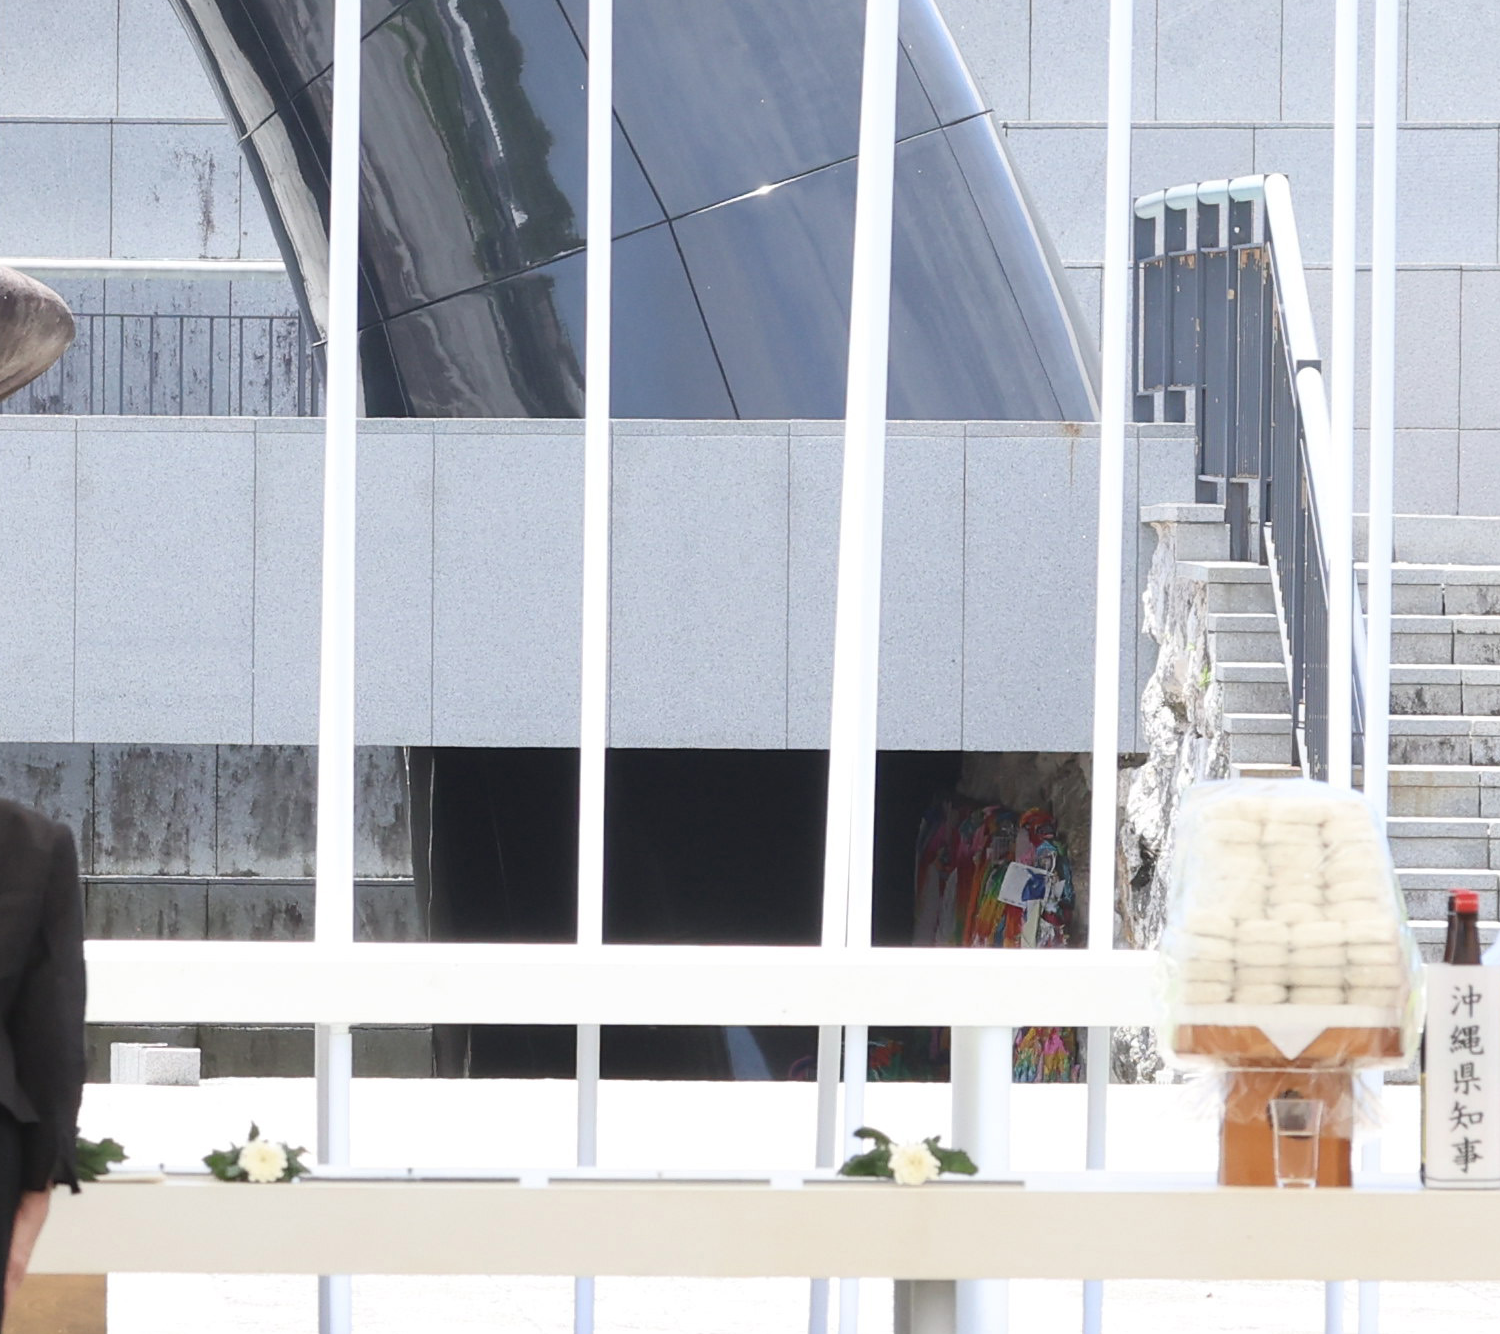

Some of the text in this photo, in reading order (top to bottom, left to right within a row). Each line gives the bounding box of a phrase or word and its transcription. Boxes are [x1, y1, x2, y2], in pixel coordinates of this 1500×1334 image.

[1449, 984, 1484, 1174] 沖縄県知事
